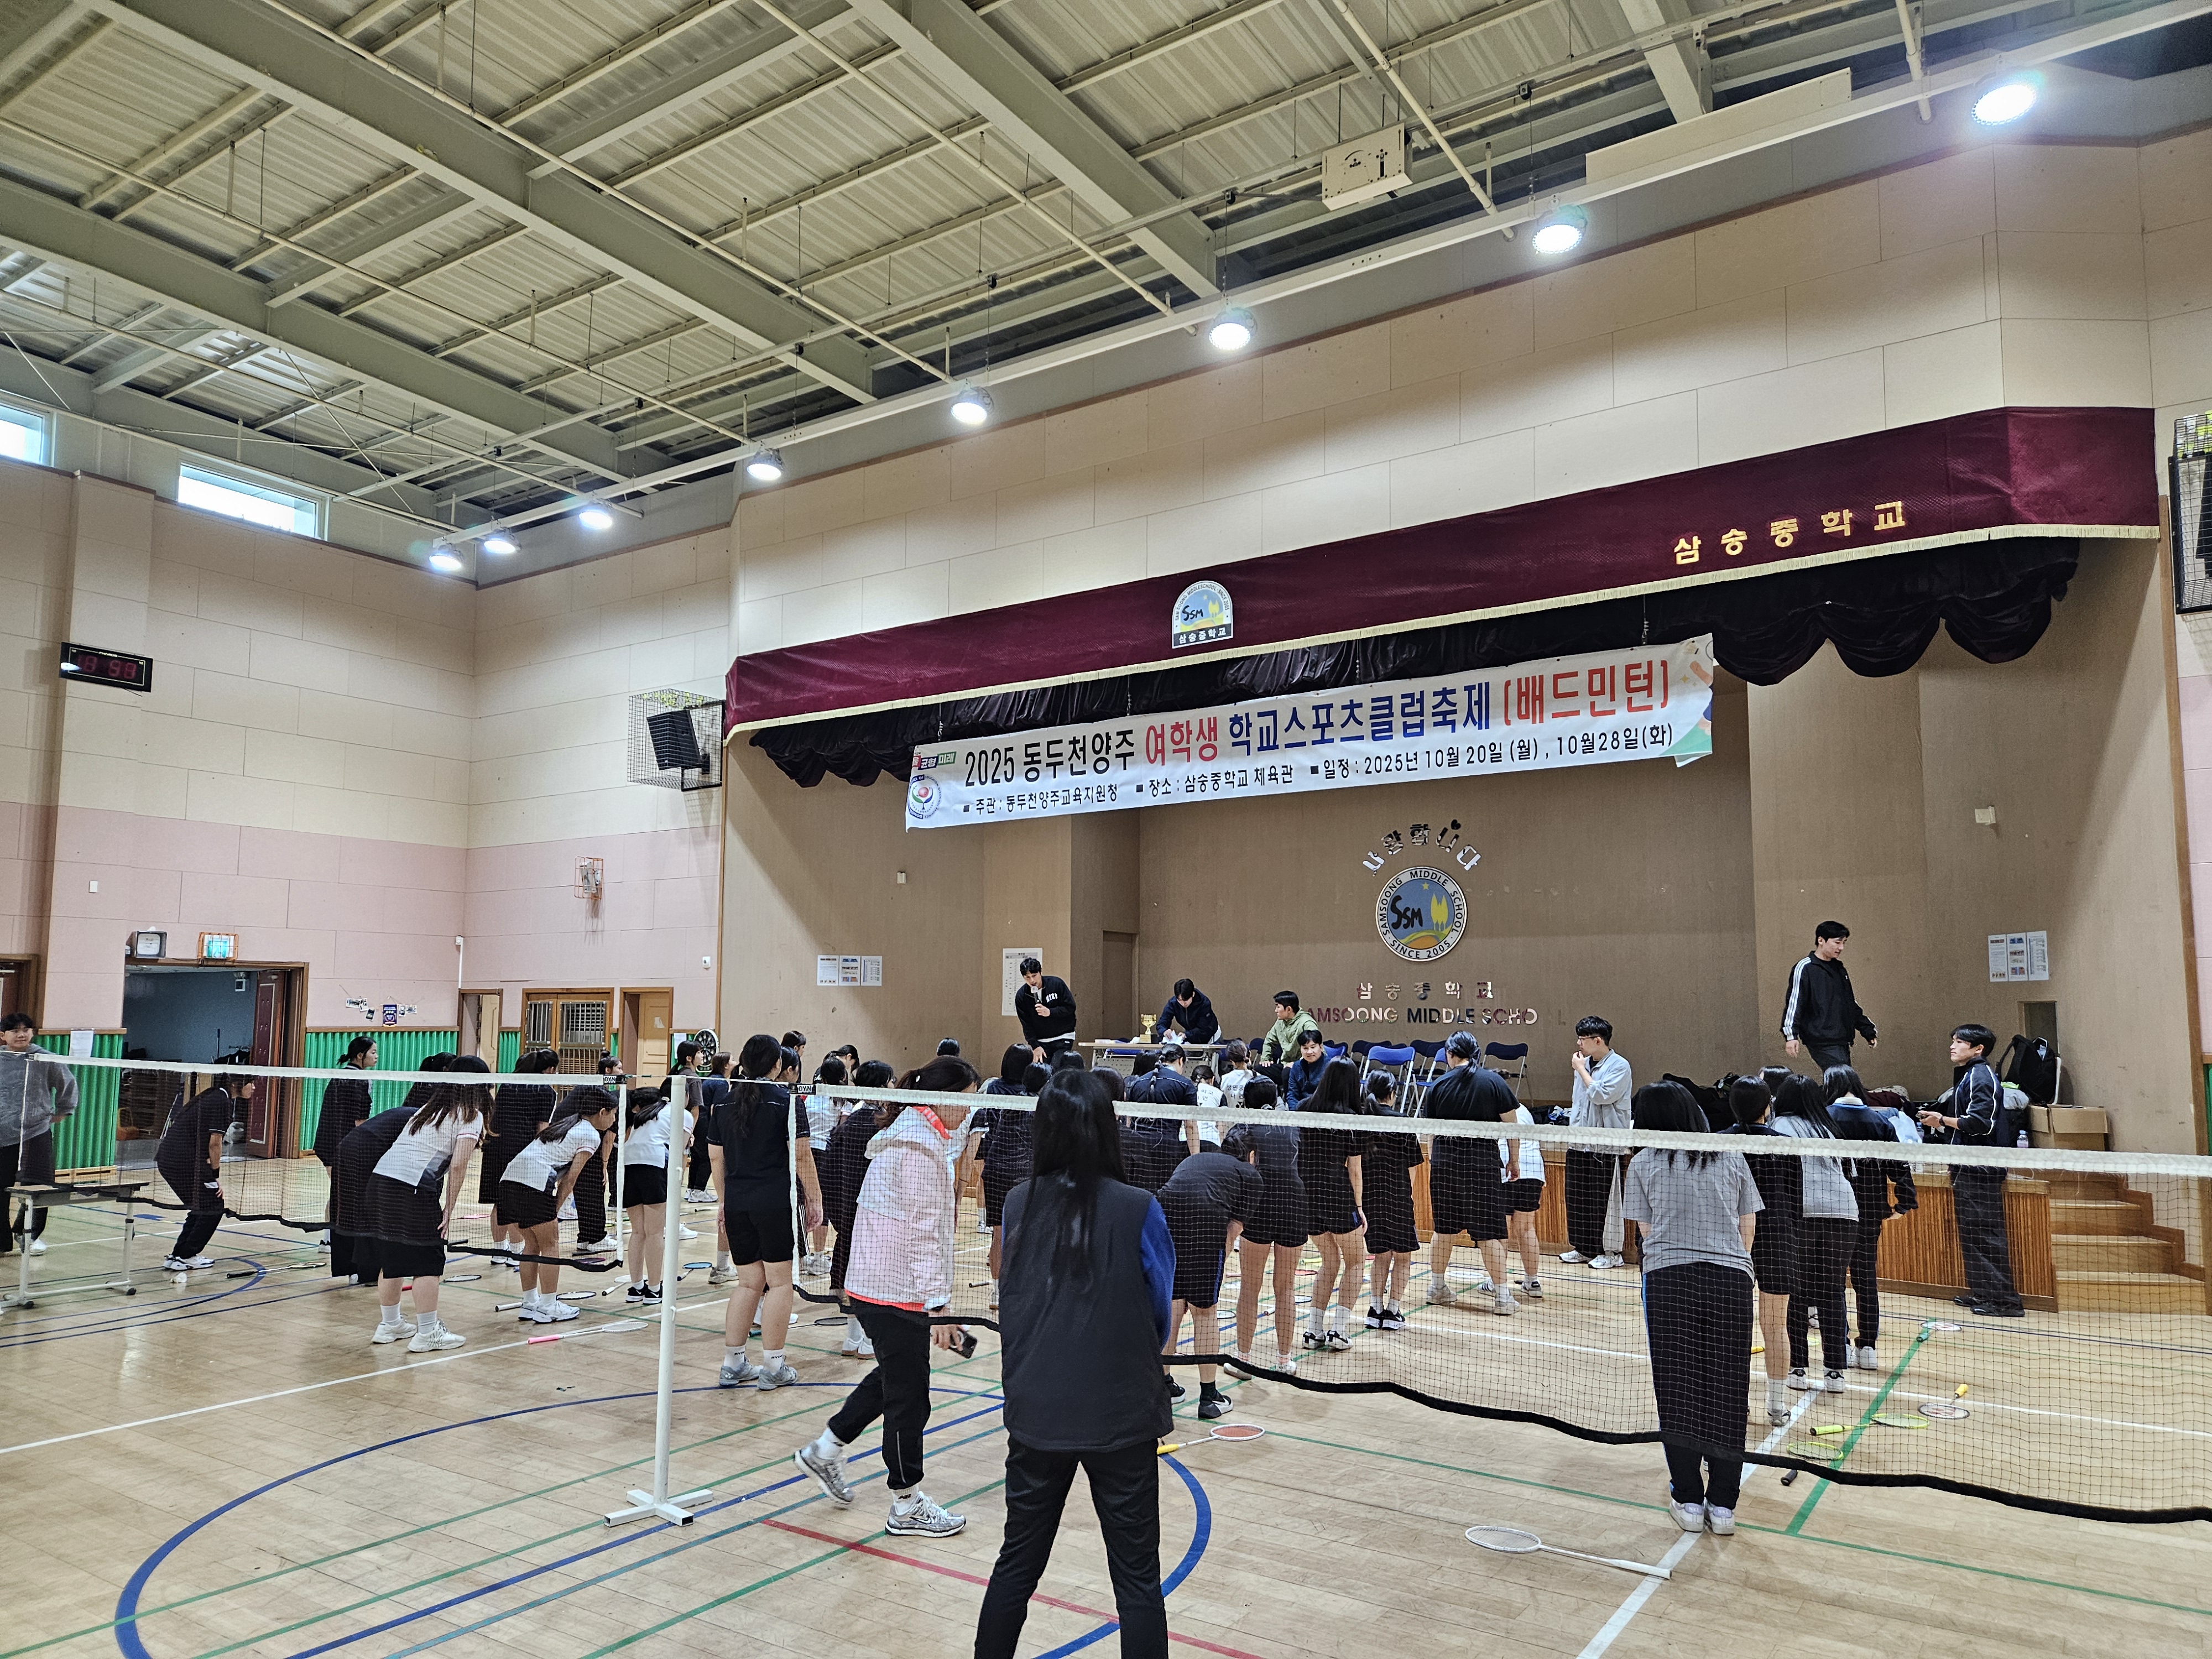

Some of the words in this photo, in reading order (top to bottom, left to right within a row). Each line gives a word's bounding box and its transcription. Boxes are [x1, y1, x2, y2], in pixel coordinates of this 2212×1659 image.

[1673, 500, 1905, 565] 삼숭중학교
[1179, 627, 1226, 644] 삼숭중학교
[965, 747, 1014, 787] 2025
[1023, 729, 1135, 782] 동두천양주
[1145, 716, 1217, 766] 여학생
[1229, 681, 1490, 757] 학교스포츠클럽축제
[1504, 660, 1668, 726] (배드민턴)
[921, 757, 937, 769] 균형
[938, 753, 955, 764] 미래
[1324, 758, 1349, 780] 일정
[1364, 751, 1418, 774] 2025년
[1425, 747, 1459, 768] 10월
[1466, 742, 1503, 764] 20일
[1149, 778, 1172, 797] 장소
[1185, 769, 1248, 793] 삼숭중학교
[1254, 764, 1293, 786] 체육관
[976, 797, 995, 815] 주관
[1006, 784, 1118, 812] 동두천양주교육지원청
[1379, 878, 1402, 936] SAMSOONG
[1410, 870, 1448, 886] MIDDLE
[1450, 890, 1463, 933] SCHOOL
[1390, 940, 1420, 958] SINCE
[1427, 940, 1451, 958] 2005
[1357, 981, 1493, 1000] 삼숭중학교
[1307, 1007, 1398, 1024] AMSOONG
[1407, 1008, 1474, 1024] MIDDLE
